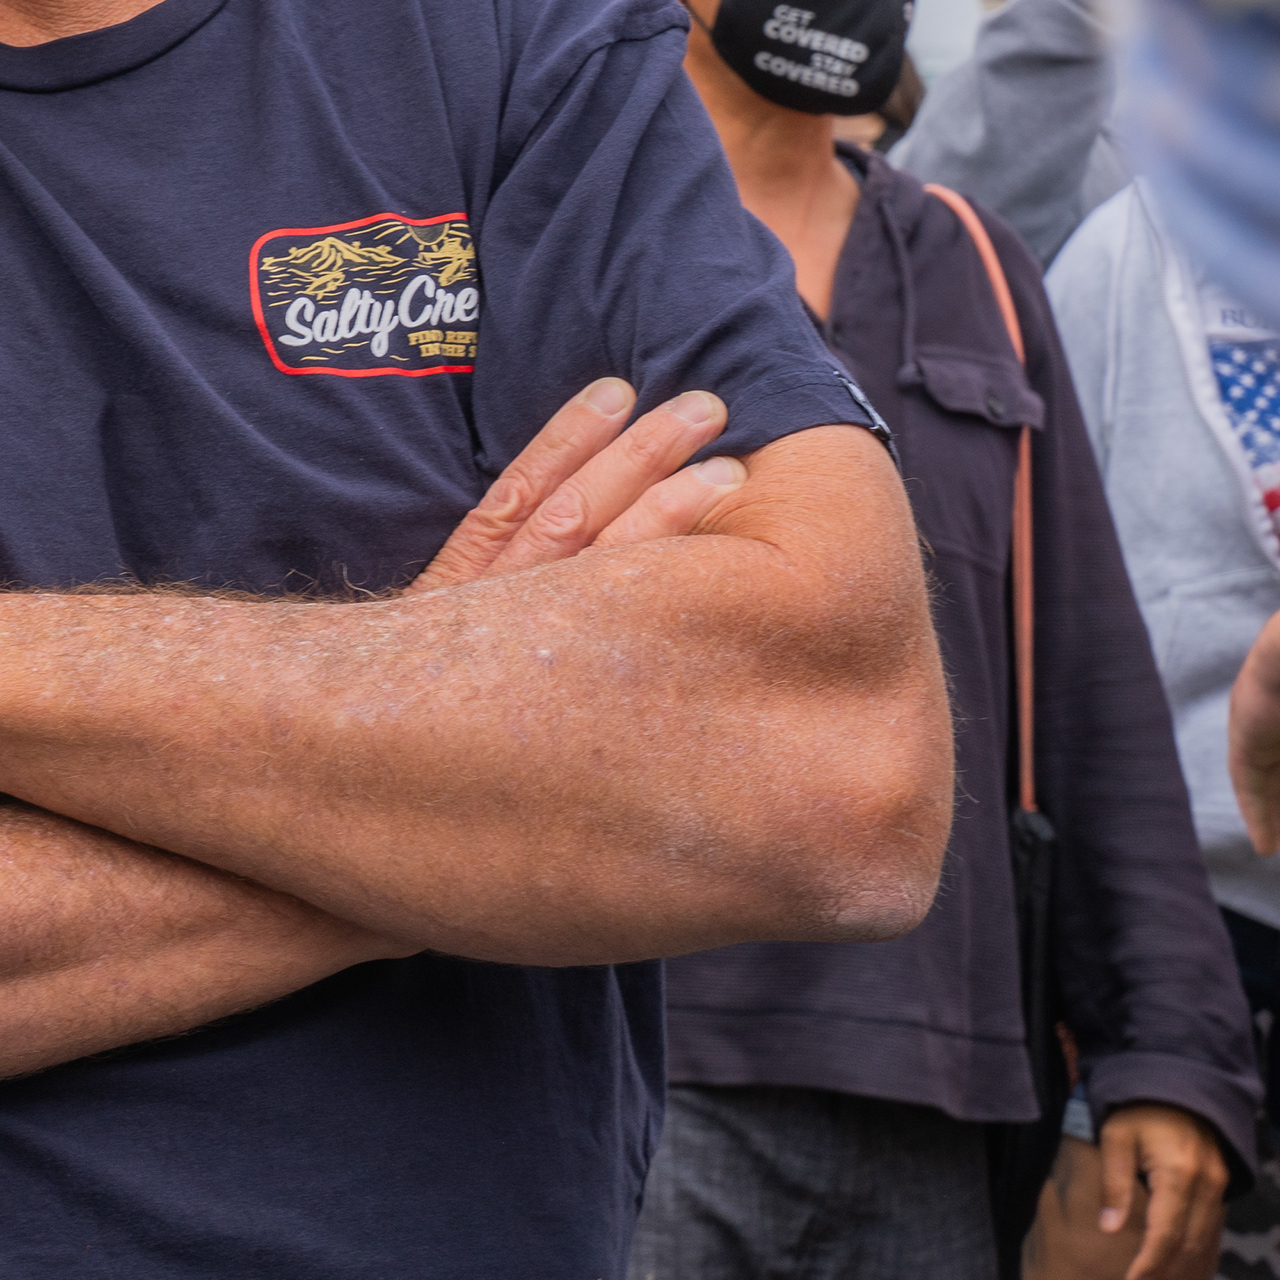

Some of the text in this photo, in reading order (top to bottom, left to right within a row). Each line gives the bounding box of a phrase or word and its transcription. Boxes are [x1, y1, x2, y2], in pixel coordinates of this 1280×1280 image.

[773, 4, 816, 28] GET
[762, 18, 870, 63] COVERED
[753, 51, 860, 98] COVERED
[810, 52, 858, 77] STAY
[278, 287, 400, 358] Salty
